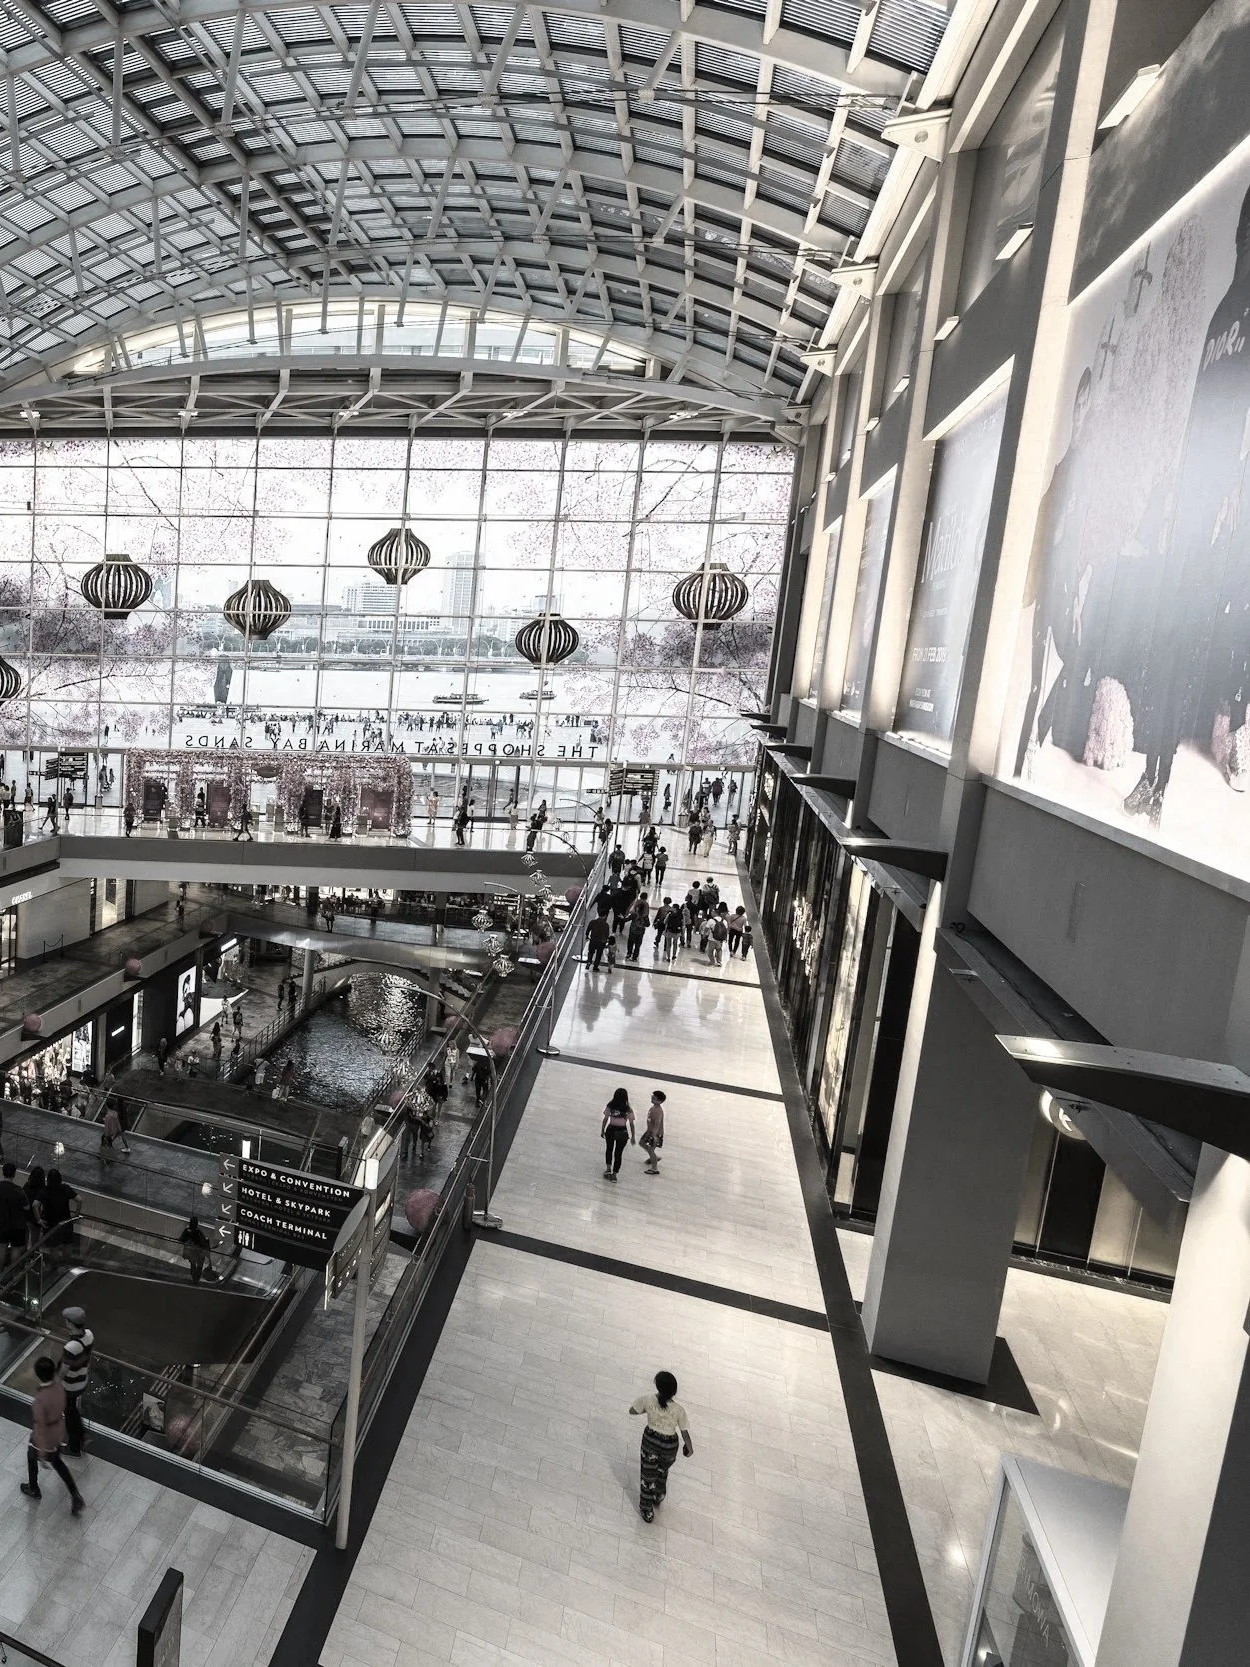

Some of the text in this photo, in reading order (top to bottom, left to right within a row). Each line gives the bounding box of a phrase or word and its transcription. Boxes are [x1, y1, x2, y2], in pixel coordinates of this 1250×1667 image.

[242, 1164, 267, 1177] EXPO
[269, 1171, 277, 1180] &
[279, 1175, 350, 1198] CONVENTION
[241, 1187, 272, 1202] HOTEL
[275, 1196, 282, 1204] &
[284, 1199, 331, 1217] SKYPARK
[240, 1209, 273, 1224] COACH
[275, 1220, 327, 1240] TERMINAL
